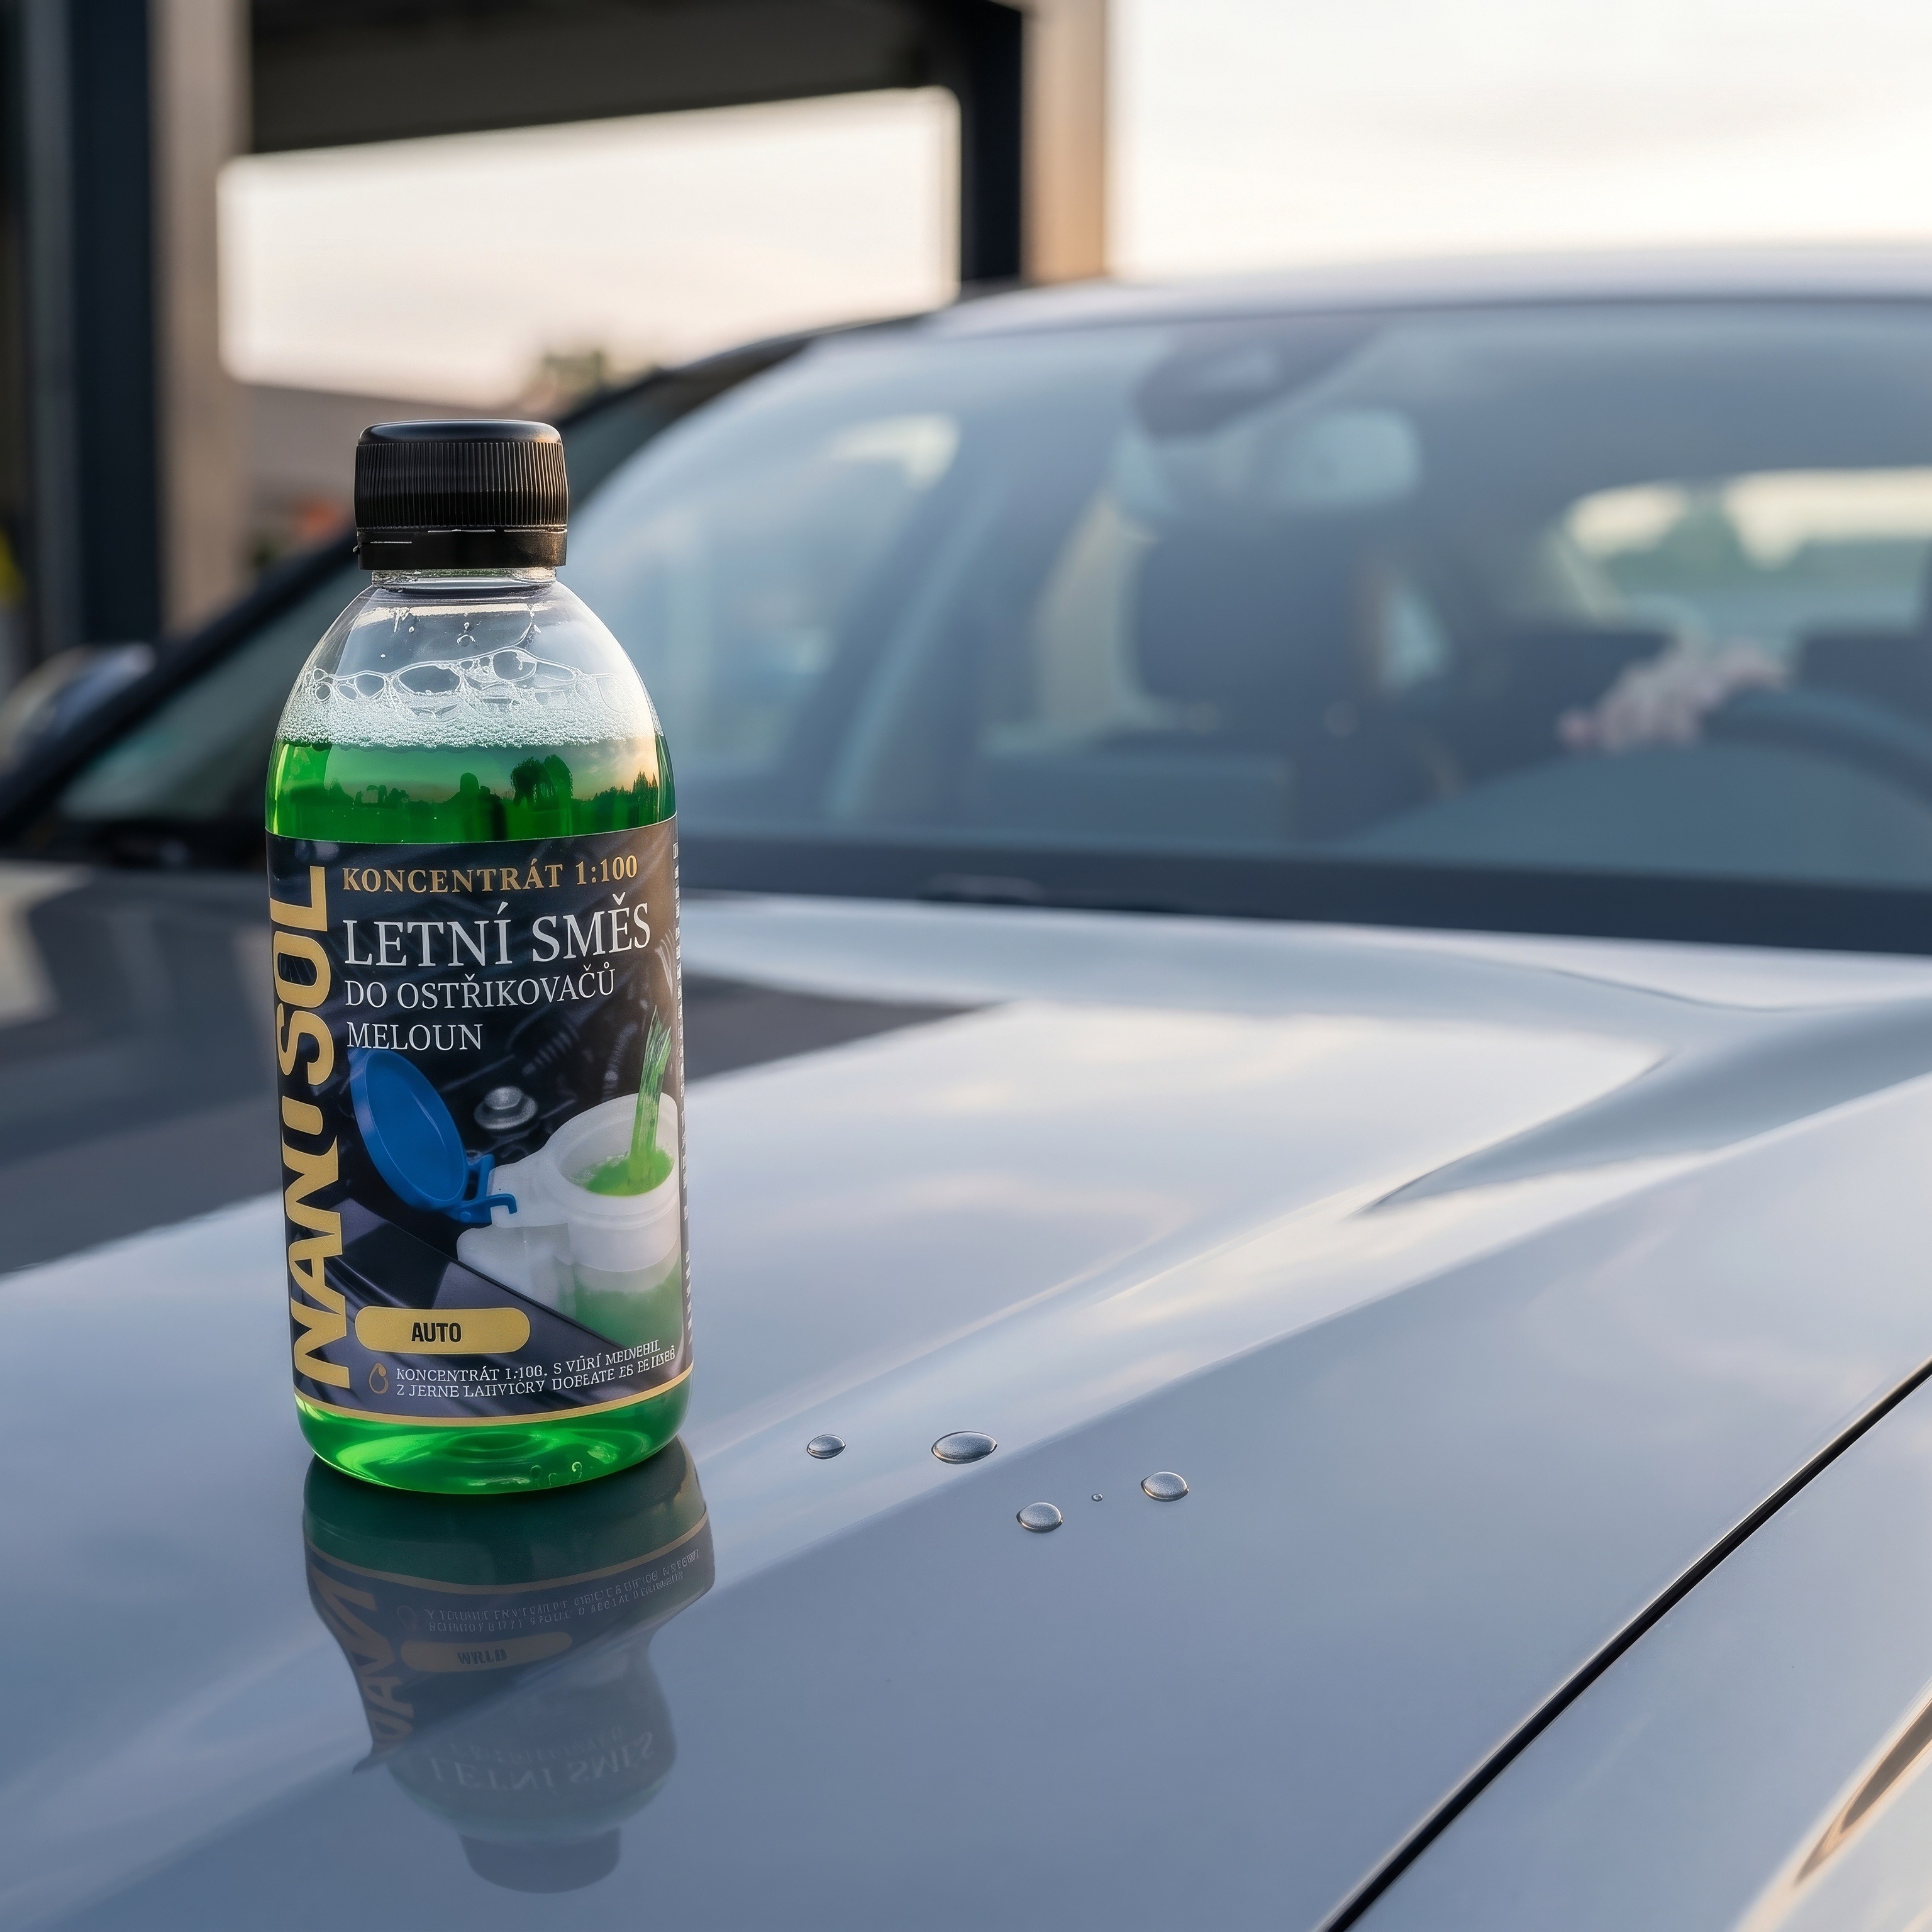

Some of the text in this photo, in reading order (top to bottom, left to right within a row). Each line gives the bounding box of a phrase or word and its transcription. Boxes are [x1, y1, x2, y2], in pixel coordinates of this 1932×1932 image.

[342, 855, 638, 893] KONCENTRÁT 1:100
[343, 892, 652, 967] LETNÍ SMĚS
[345, 962, 616, 1009] DO OSTŘIKOVAČŮ
[347, 1021, 484, 1051] MELOUN
[411, 1322, 462, 1343] AUTO
[553, 1362, 562, 1374] S
